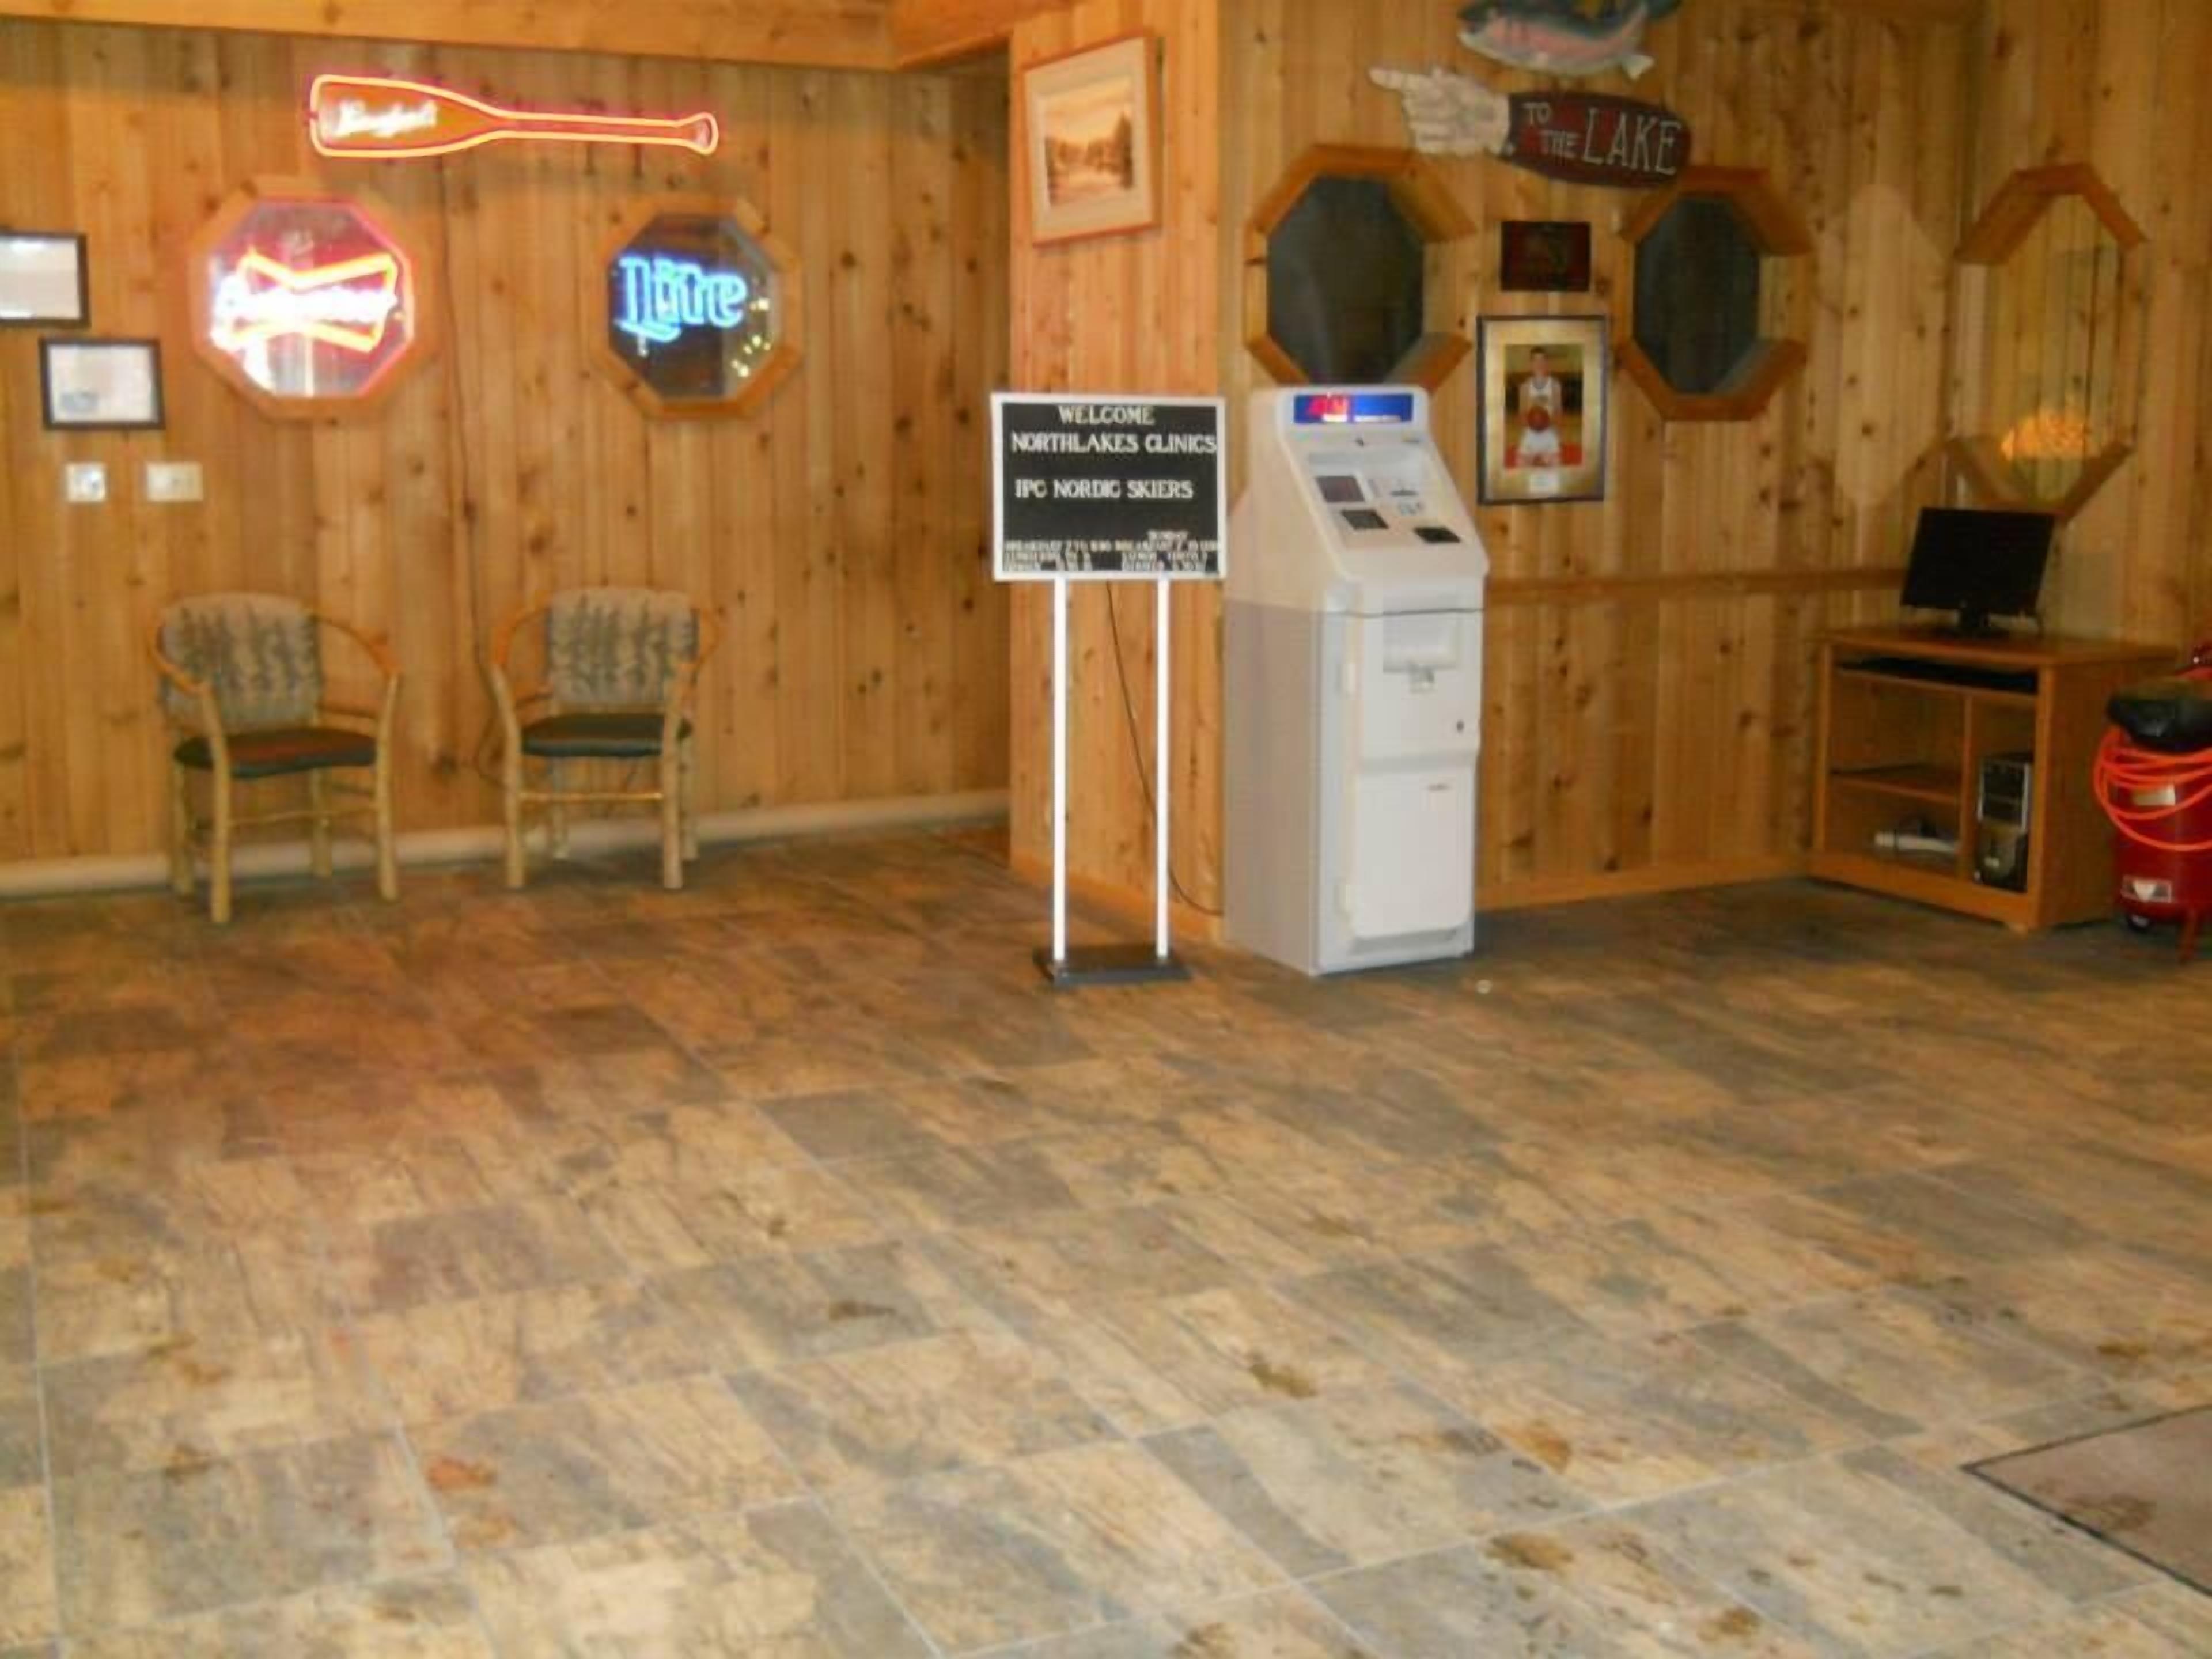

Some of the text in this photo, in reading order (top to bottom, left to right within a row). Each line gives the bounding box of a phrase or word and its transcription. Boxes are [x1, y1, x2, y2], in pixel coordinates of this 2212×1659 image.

[1523, 102, 1551, 125] TO
[1540, 107, 1683, 176] THE LAKE
[1057, 405, 1156, 425] WELCOME
[1012, 430, 1217, 454] NORTHLAKES CLINICS
[1054, 479, 1122, 499] NORDIC
[1127, 479, 1194, 499] SKIERS
